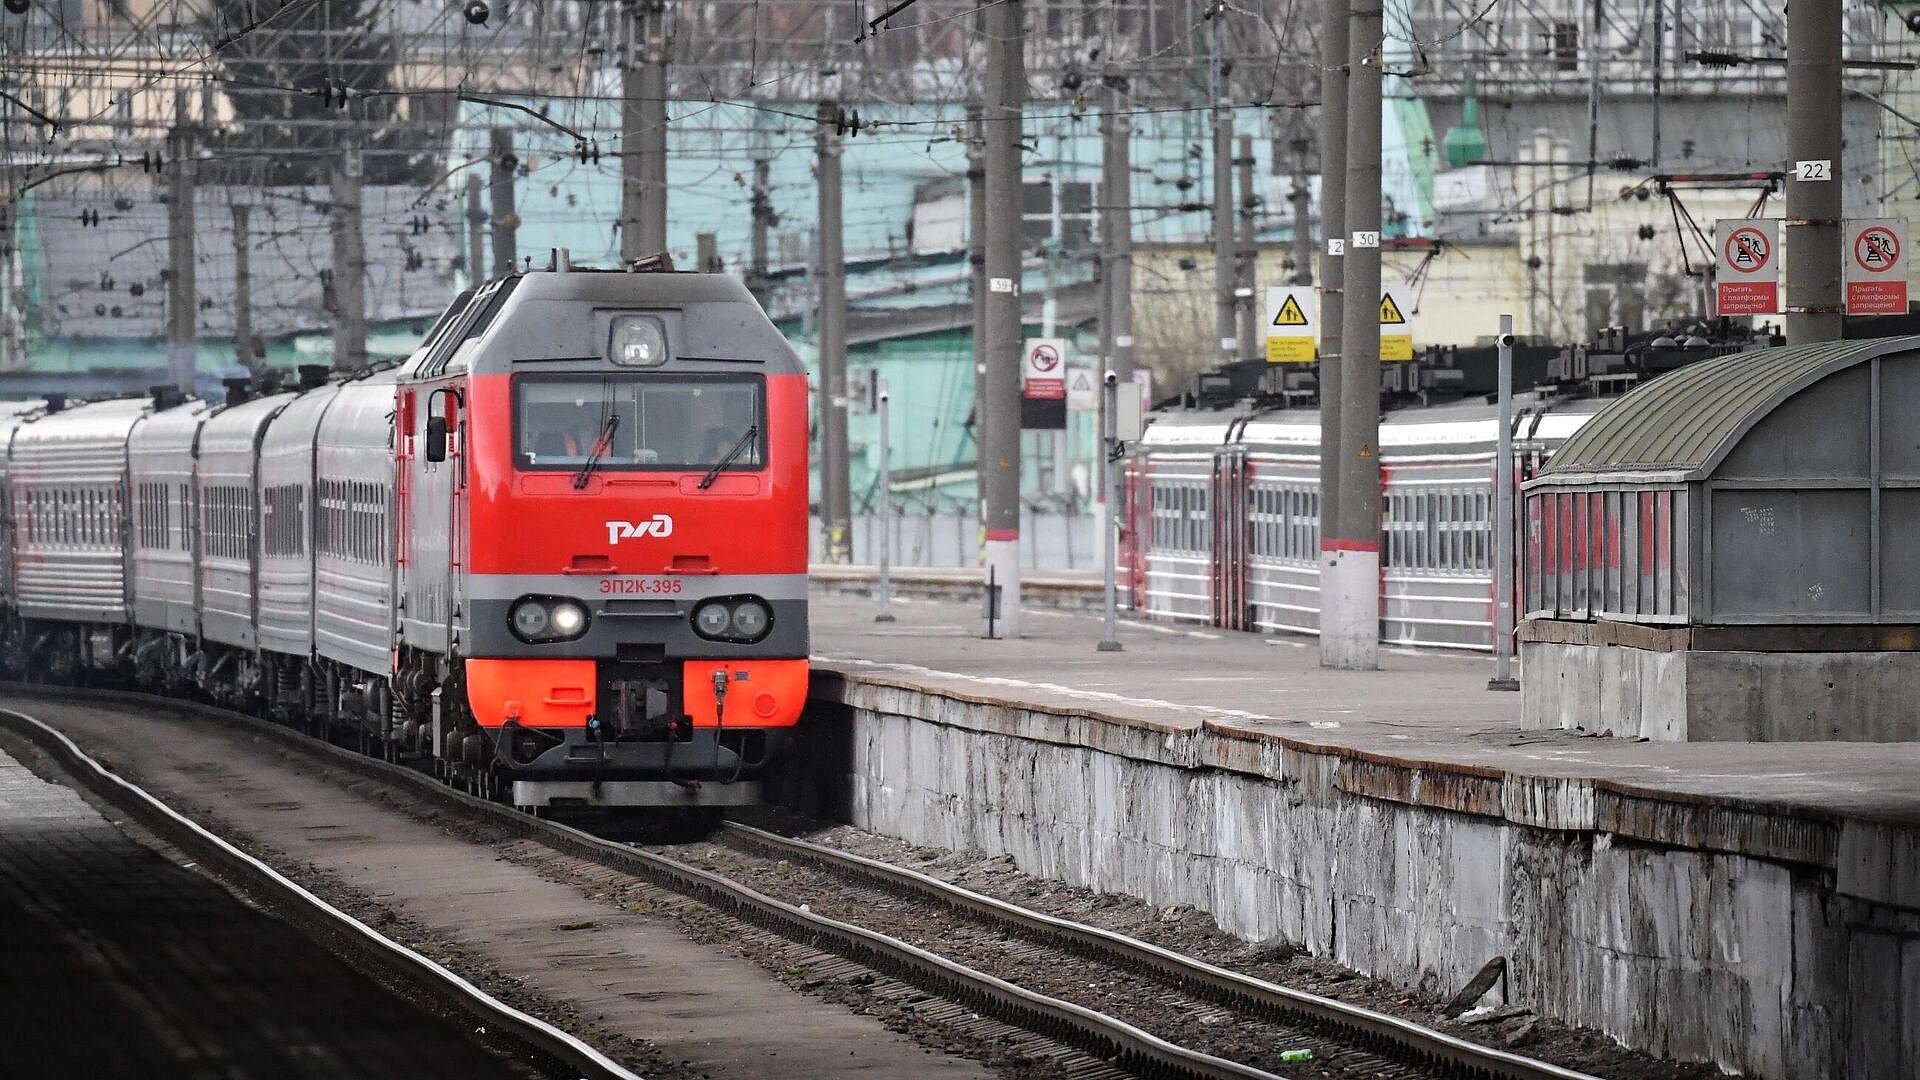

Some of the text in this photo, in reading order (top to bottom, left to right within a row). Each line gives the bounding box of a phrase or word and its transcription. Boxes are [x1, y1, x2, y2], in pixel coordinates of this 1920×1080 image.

[1803, 163, 1824, 179] 22
[1359, 233, 1375, 246] 30
[1722, 285, 1753, 293] Прыгать
[1851, 285, 1884, 293] Прыгать
[1727, 294, 1770, 302] платформы
[1856, 294, 1900, 302] платформы
[1723, 302, 1767, 310] запрещено!
[1852, 301, 1896, 309] запрещено!
[599, 579, 682, 594] ЭП2К-395
